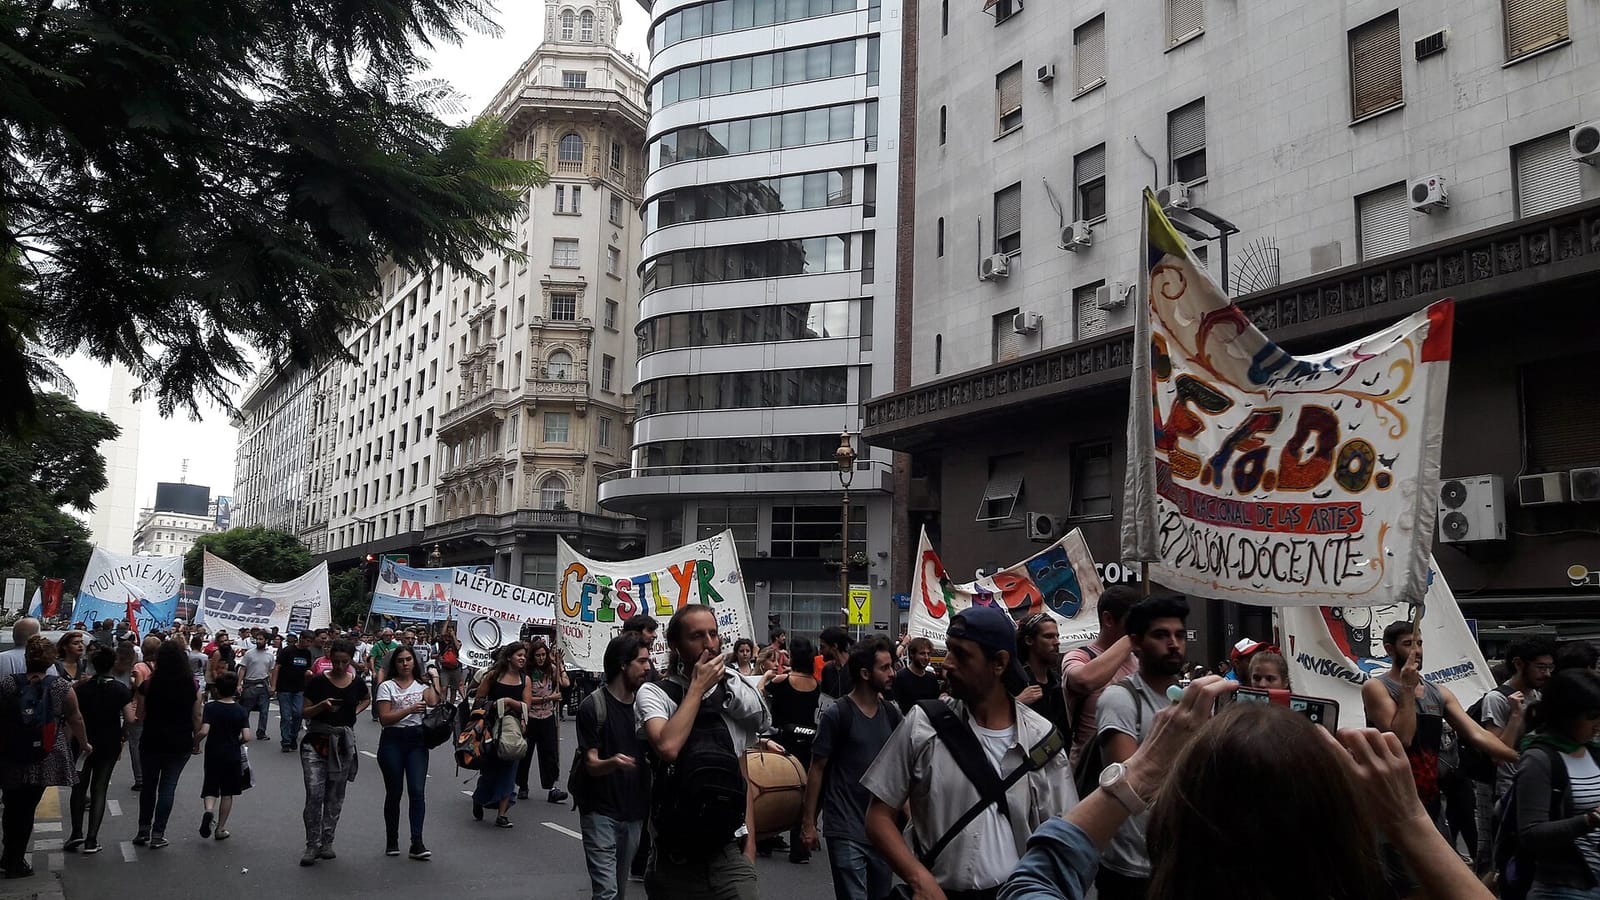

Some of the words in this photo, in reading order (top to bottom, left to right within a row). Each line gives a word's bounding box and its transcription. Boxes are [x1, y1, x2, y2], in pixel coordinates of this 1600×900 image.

[1256, 503, 1274, 528] DE
[1278, 505, 1301, 530] LAS
[1306, 506, 1358, 532] ARTES
[89, 563, 176, 598] MOVIMIENTO
[455, 570, 467, 587] LA
[471, 574, 491, 593] LEY
[494, 580, 508, 598] DE
[204, 587, 276, 617] CTA
